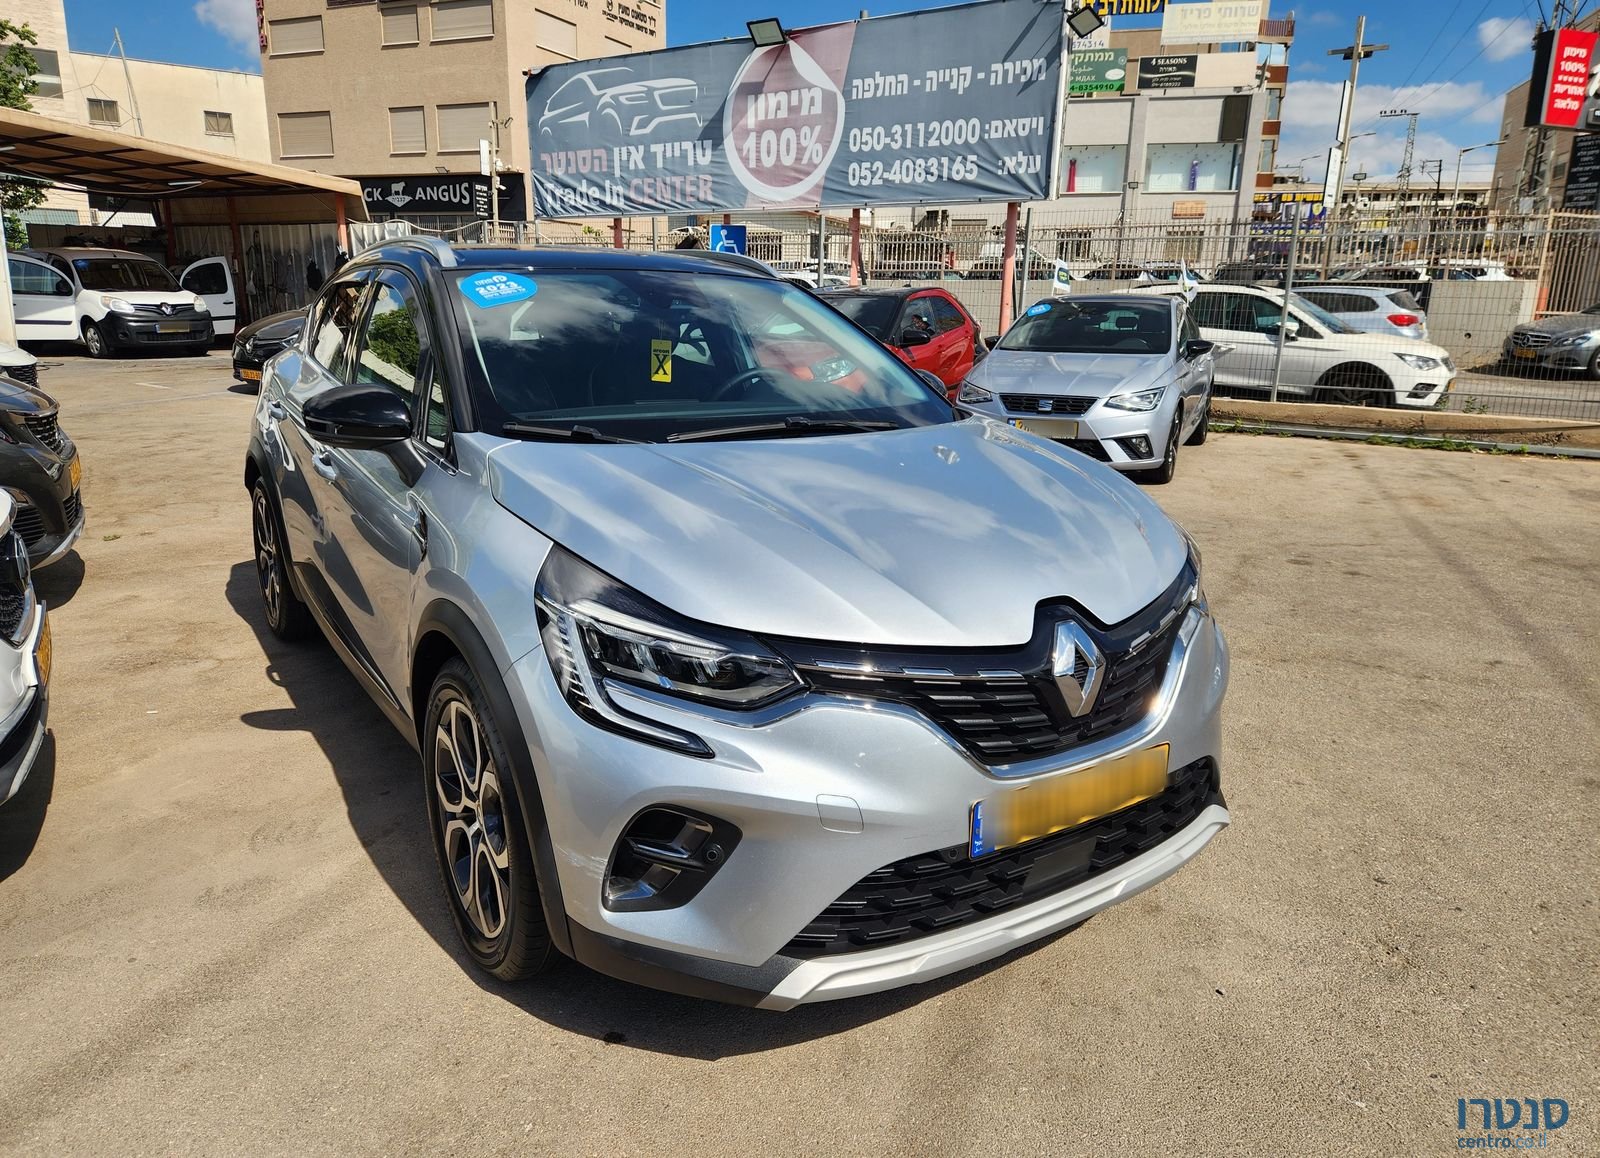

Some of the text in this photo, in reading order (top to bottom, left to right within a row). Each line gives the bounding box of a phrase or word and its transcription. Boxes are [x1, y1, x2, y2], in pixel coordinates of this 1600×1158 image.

[989, 57, 1047, 86] מכירה
[1151, 57, 1188, 66] 4 SEASONS
[1560, 61, 1586, 73] 100%
[852, 71, 909, 100] החלפה
[925, 66, 973, 95] קנייה
[746, 86, 823, 129] מימון
[742, 125, 823, 169] 100%
[849, 117, 981, 152] 050-3112000
[540, 140, 713, 178] טרייד אין הסנטר
[848, 154, 978, 187] 052-4083165
[415, 182, 470, 205] ANGUS
[544, 174, 713, 208] Trade In CENTER
[653, 353, 668, 375] X
